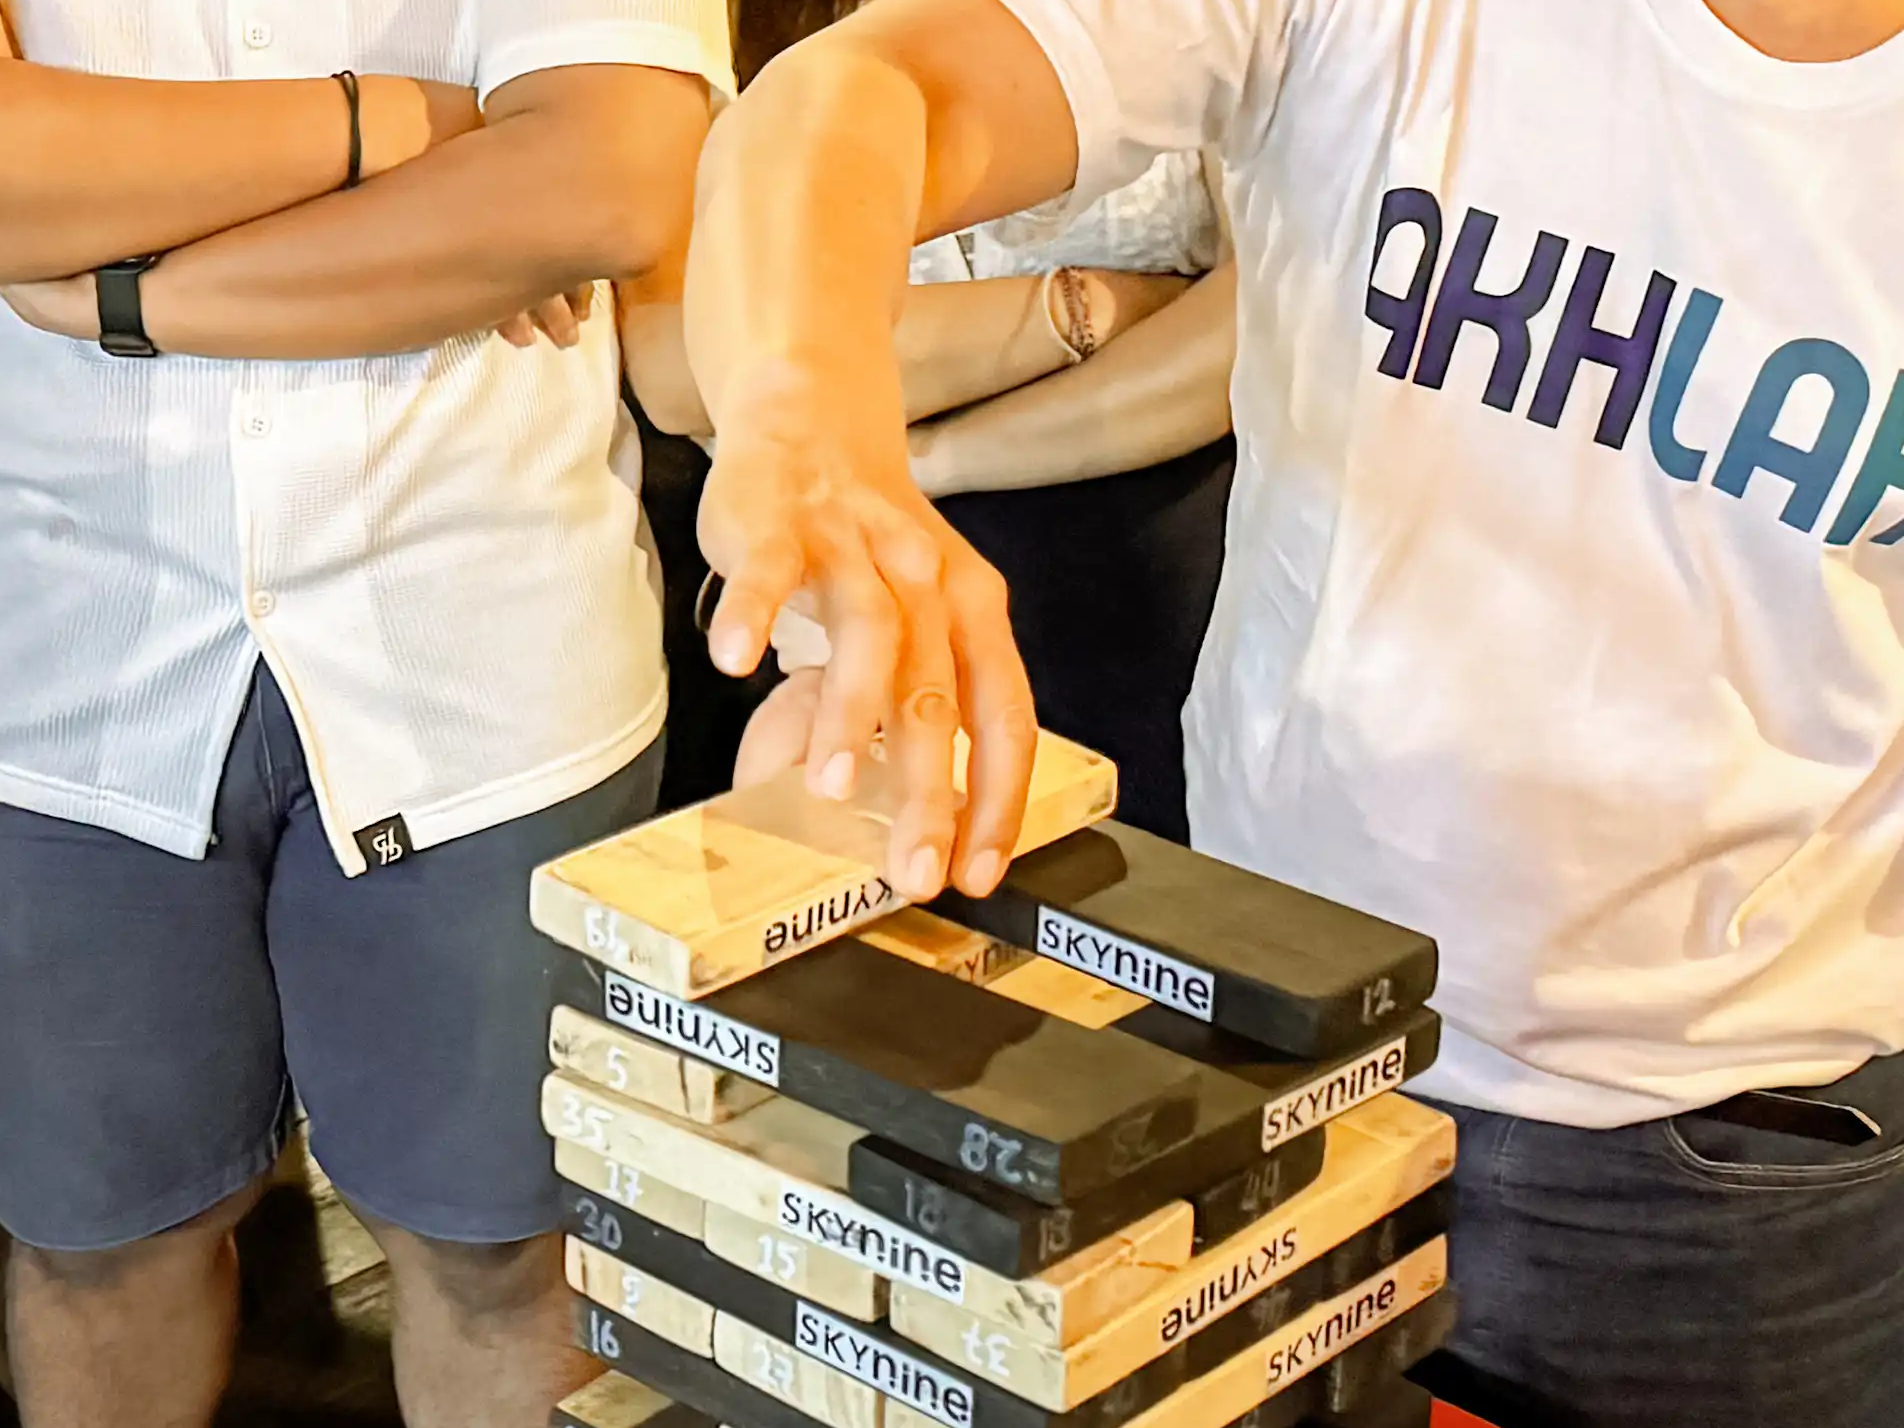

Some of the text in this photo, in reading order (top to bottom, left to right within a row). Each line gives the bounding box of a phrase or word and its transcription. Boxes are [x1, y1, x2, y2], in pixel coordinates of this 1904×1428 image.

[765, 877, 893, 953] KYnine
[605, 1048, 629, 1089] 5
[756, 1234, 799, 1281] 15
[587, 1309, 619, 1358] 16
